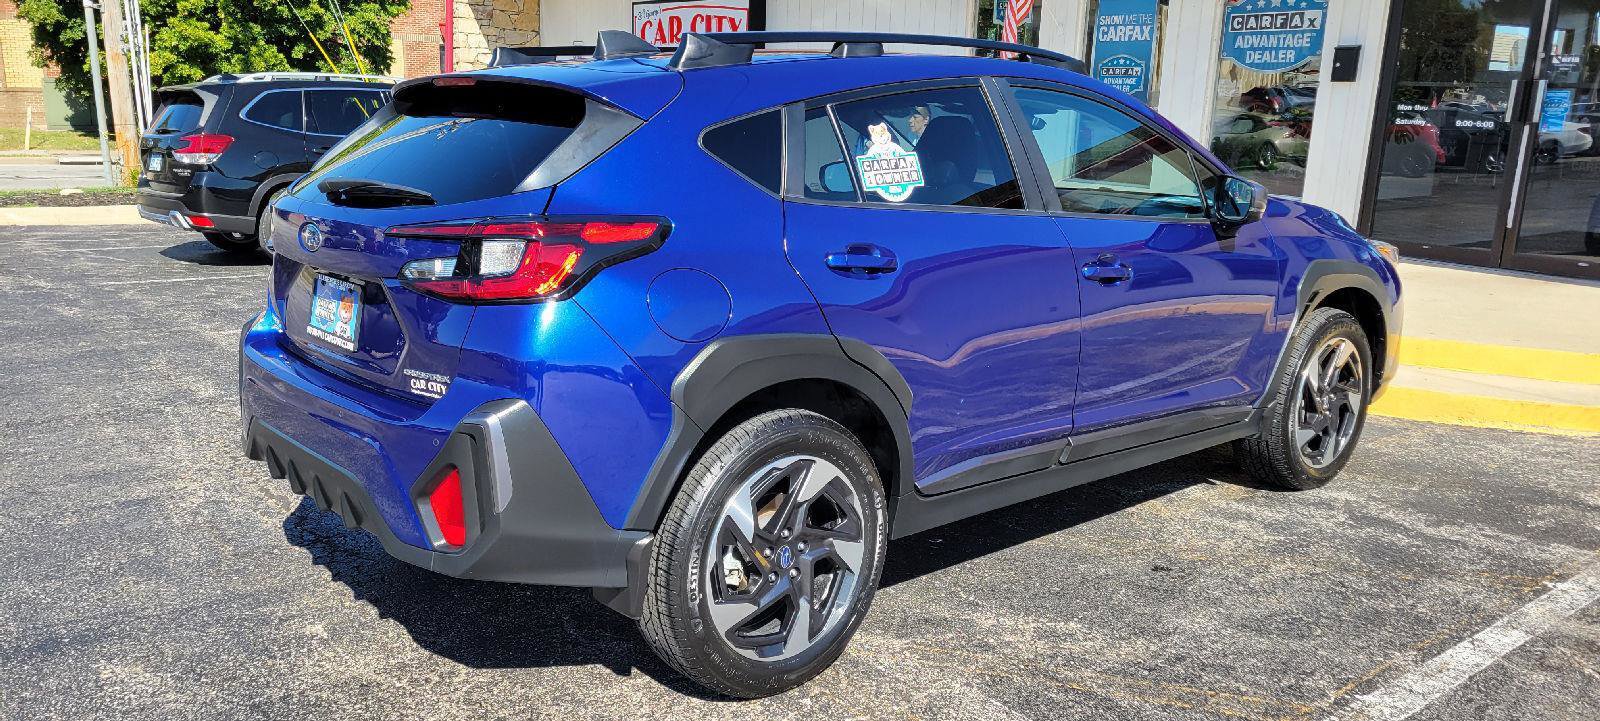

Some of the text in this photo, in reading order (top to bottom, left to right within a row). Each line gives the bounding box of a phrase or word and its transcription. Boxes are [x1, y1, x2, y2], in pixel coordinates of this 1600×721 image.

[1100, 13, 1153, 26] SHOW ME THE
[1232, 13, 1319, 30] CARFAX
[640, 13, 743, 45] CAR CITY
[1099, 25, 1151, 42] CARFAX
[1234, 33, 1312, 48] ADVANTAGE
[1245, 49, 1296, 64] DEALER
[1102, 67, 1141, 76] CARFAX
[1103, 77, 1138, 85] ADVANTAGE
[1395, 118, 1427, 127] Saturday
[862, 157, 915, 172] CARFAX
[875, 169, 920, 185] OWNER
[410, 378, 427, 390] CAR
[427, 381, 447, 395] CITY
